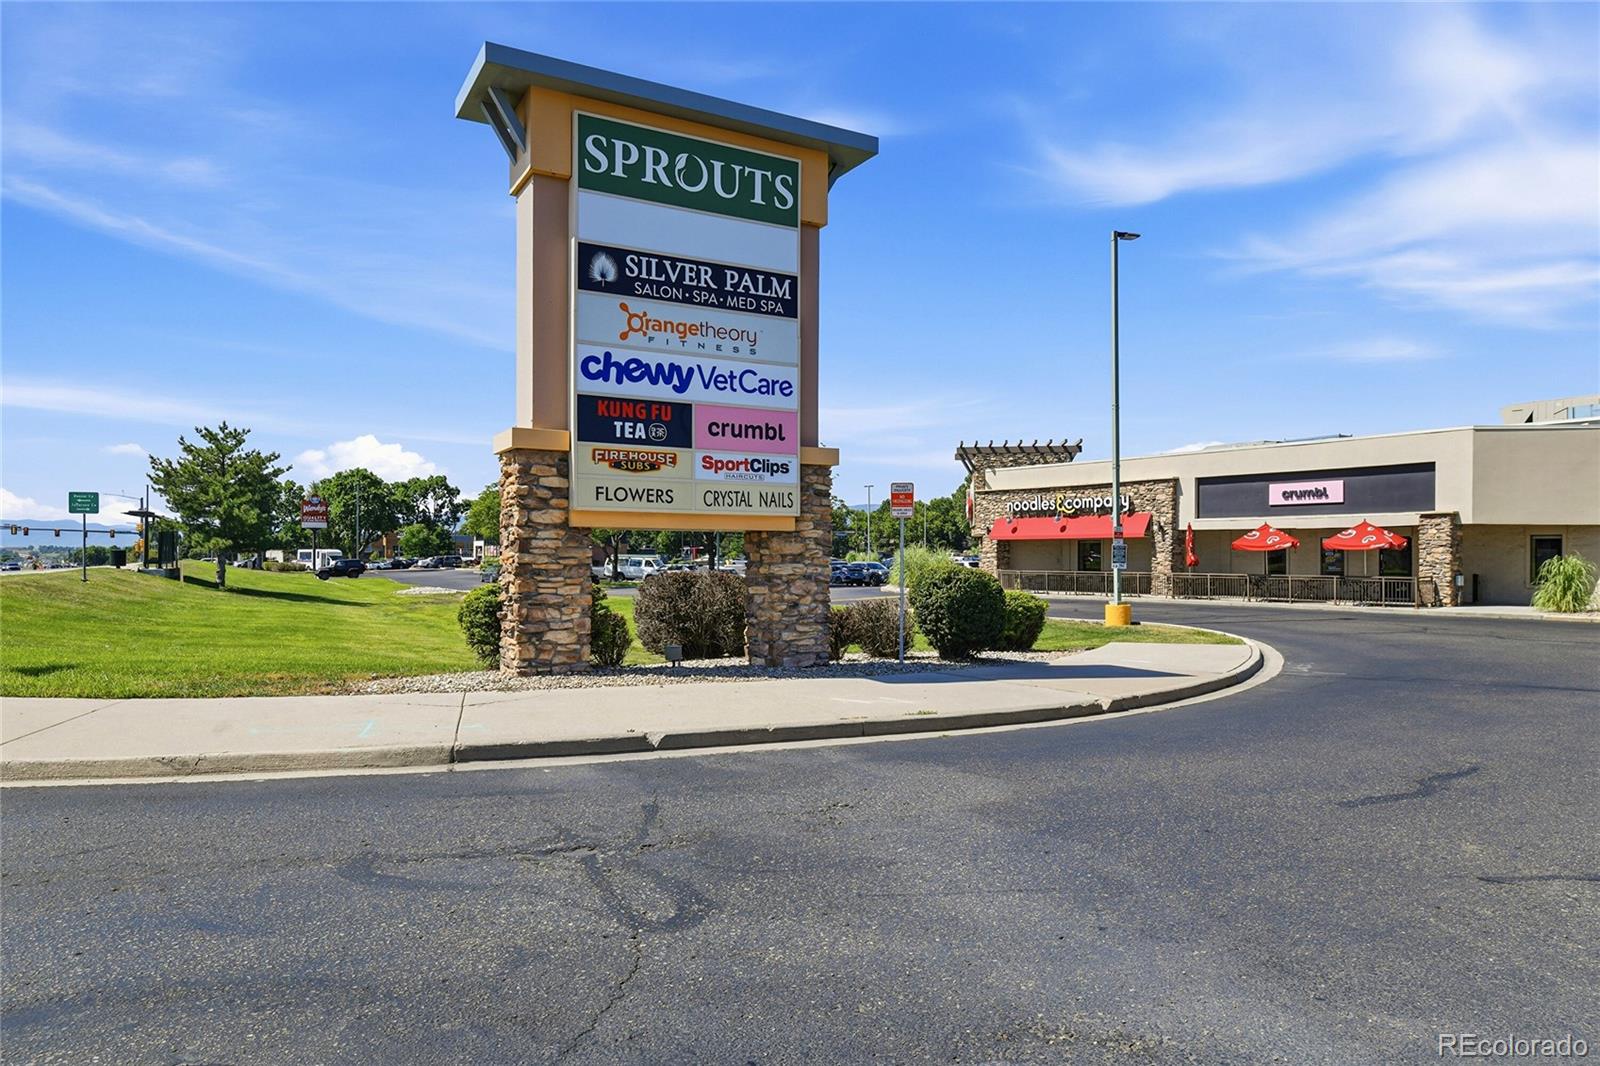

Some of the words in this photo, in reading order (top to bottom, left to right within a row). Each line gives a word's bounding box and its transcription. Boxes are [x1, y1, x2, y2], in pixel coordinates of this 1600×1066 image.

[584, 134, 794, 210] SPROUTS
[625, 254, 718, 289] SILVER
[724, 269, 792, 300] PALM
[634, 282, 683, 300] SALON
[693, 290, 718, 305] SPA
[726, 295, 756, 310] MED
[760, 299, 784, 314] SPA
[620, 303, 757, 347] Orangetheory
[648, 336, 757, 355] FITNESS
[580, 350, 694, 394] chewy
[597, 400, 647, 420] KUNG
[650, 403, 672, 421] FU
[614, 420, 646, 440] TEA
[708, 420, 786, 442] crumbl
[594, 449, 676, 467] FIREHOUSE
[620, 460, 650, 471] SUBS
[596, 486, 674, 504] FLOWERS
[703, 490, 752, 508] CRYSTAL
[759, 492, 794, 508] NAILS
[1281, 486, 1329, 502] crumbl
